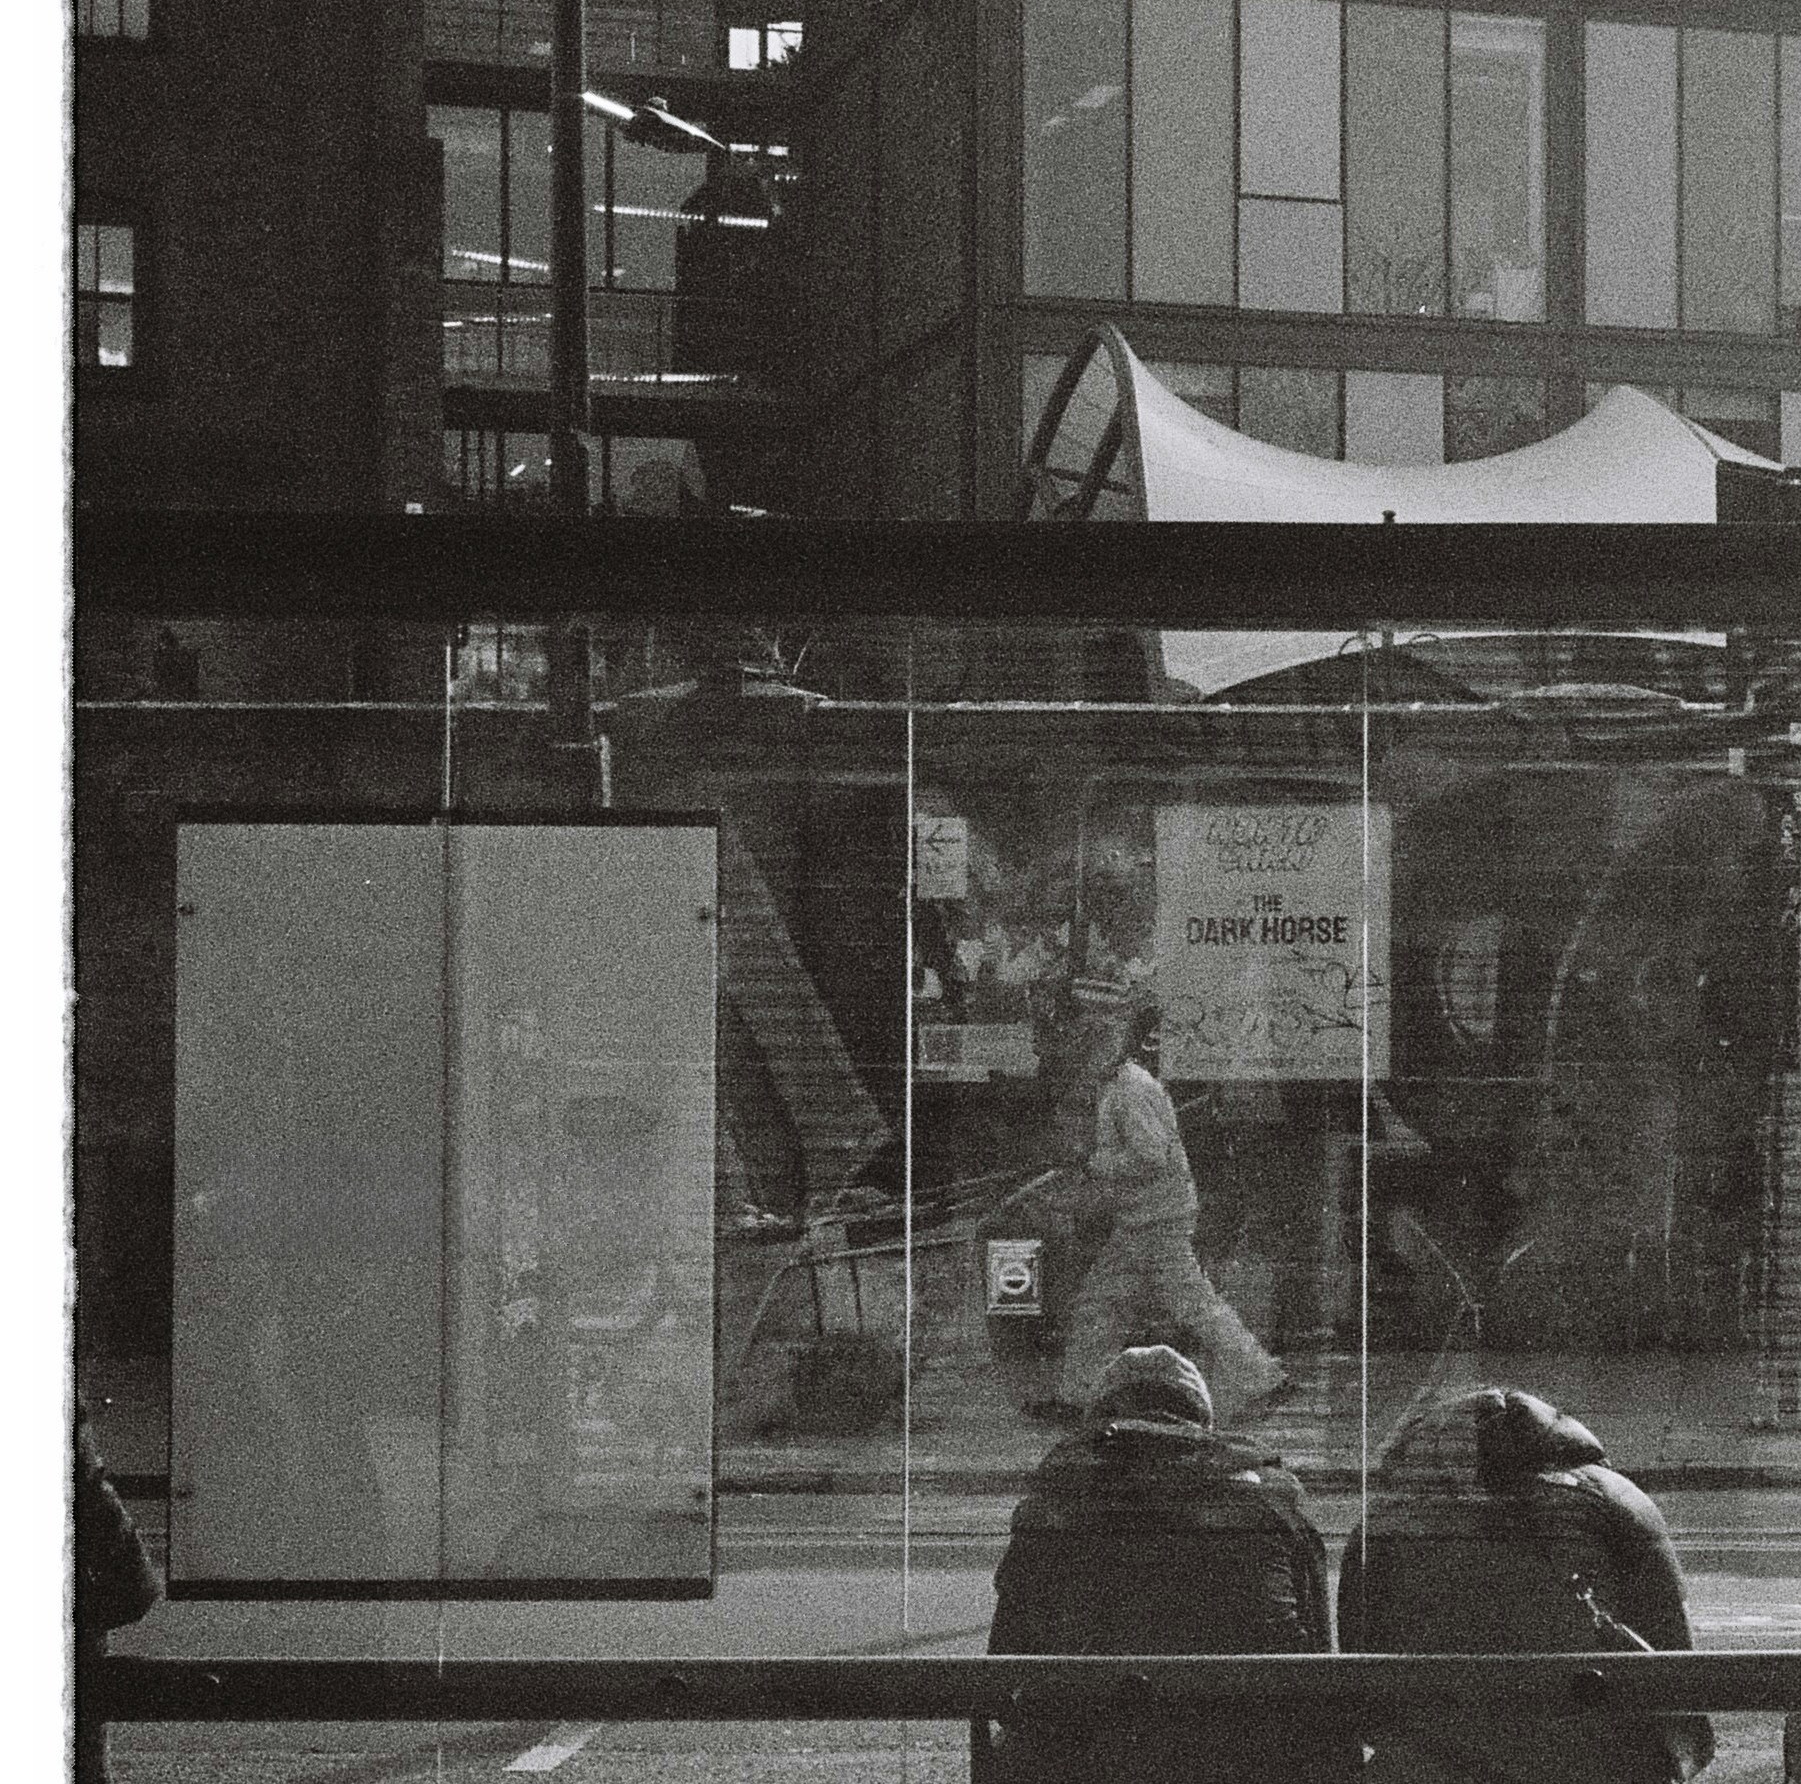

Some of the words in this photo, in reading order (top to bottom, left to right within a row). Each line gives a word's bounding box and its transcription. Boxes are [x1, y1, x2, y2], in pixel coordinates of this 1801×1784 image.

[1253, 895, 1283, 912] THE
[1186, 917, 1255, 946] DARK
[1261, 916, 1348, 945] HORSE
